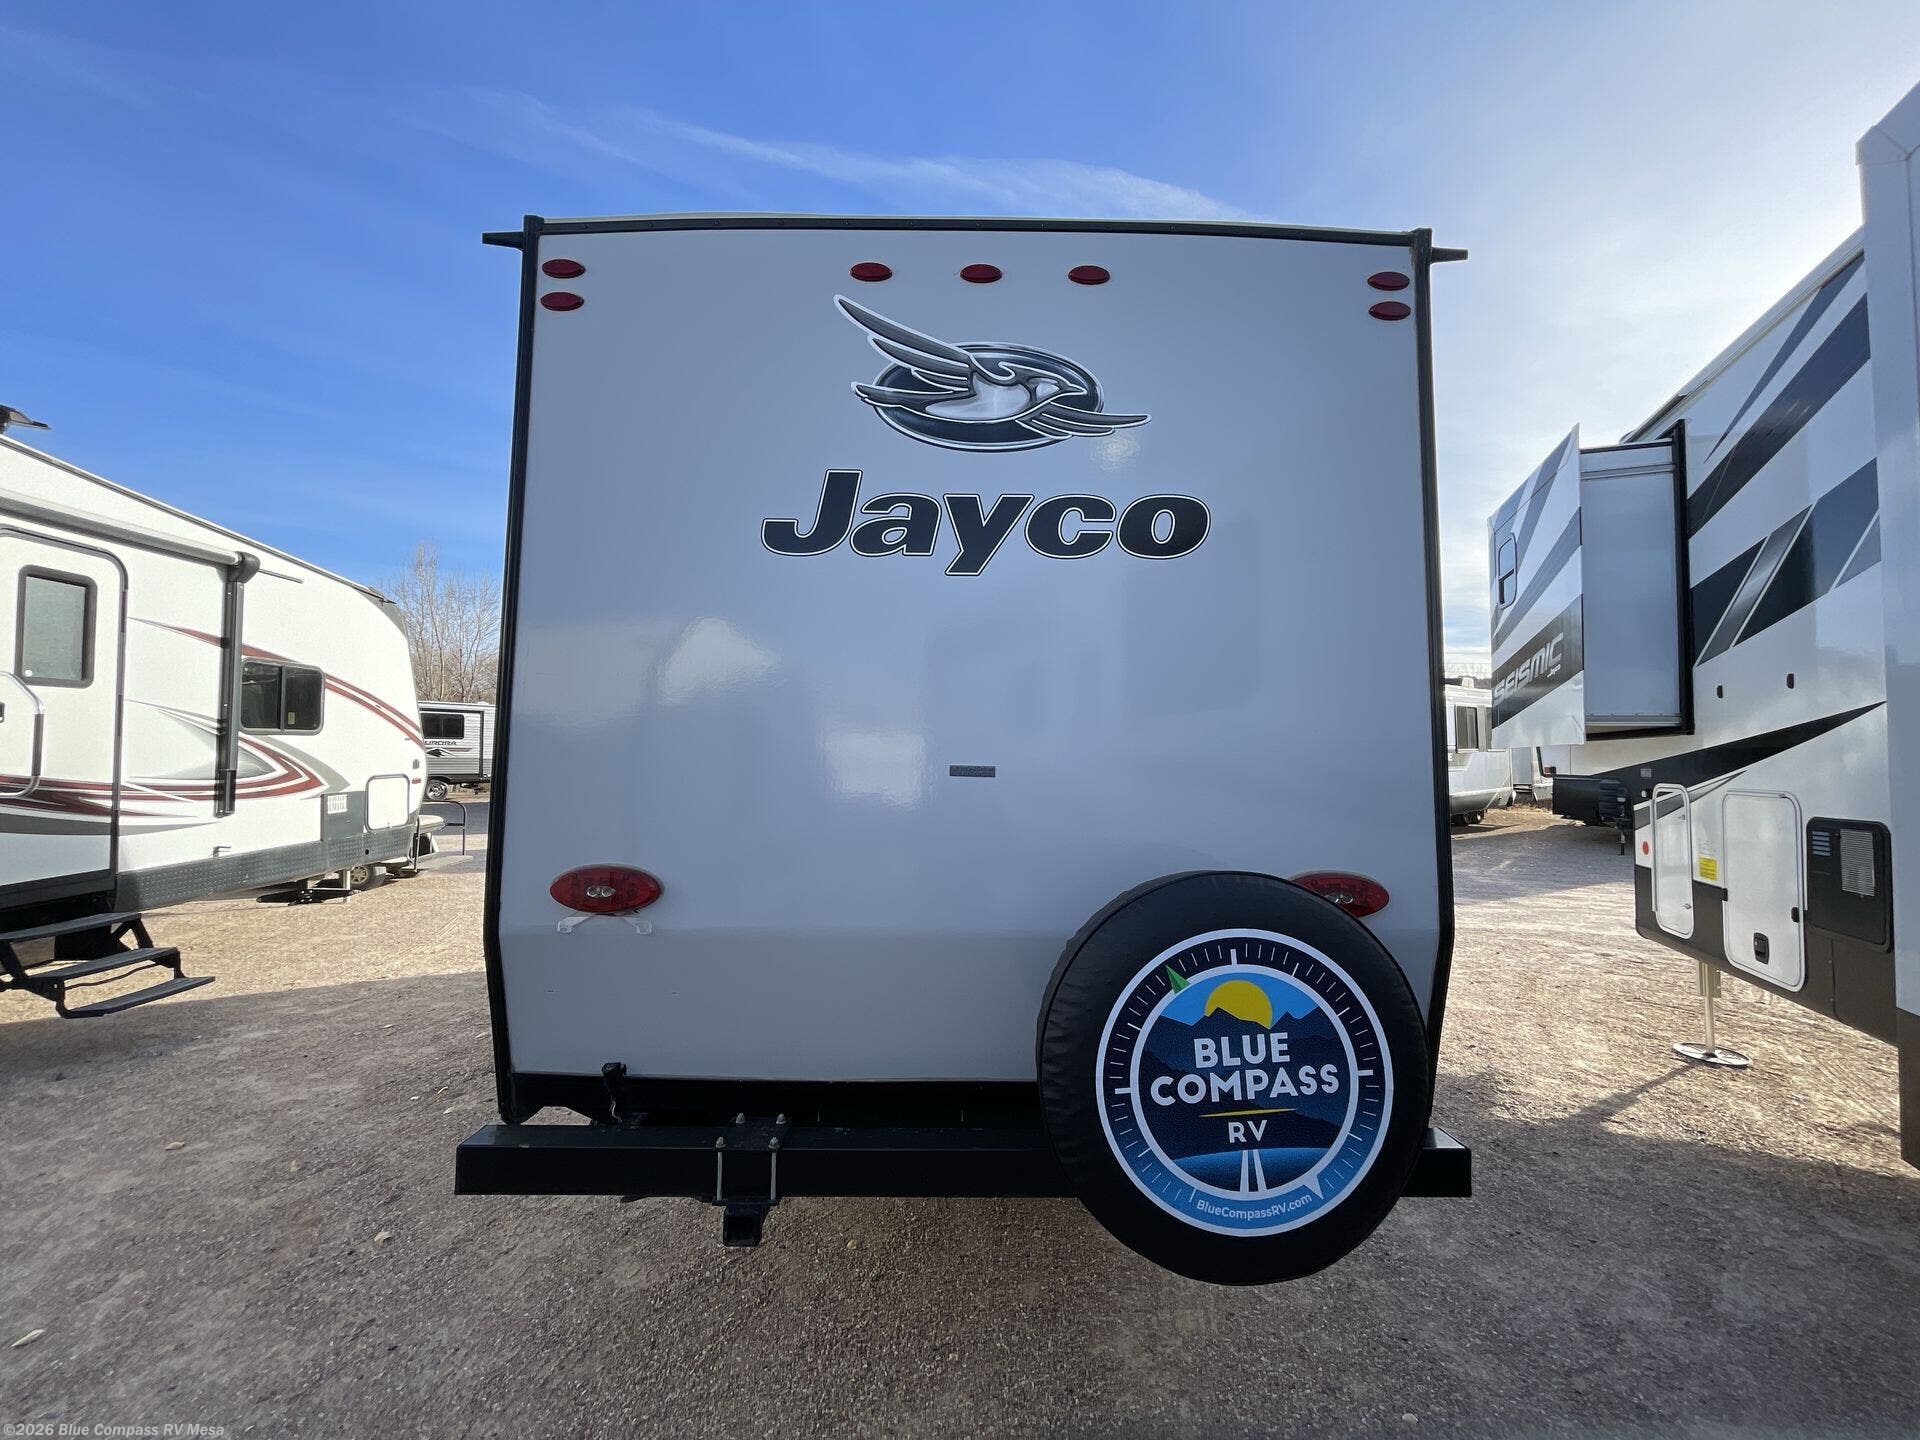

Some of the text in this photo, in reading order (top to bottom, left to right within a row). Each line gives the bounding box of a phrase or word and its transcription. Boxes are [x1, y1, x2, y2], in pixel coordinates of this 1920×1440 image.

[761, 468, 1212, 577] Jayco
[1493, 632, 1564, 707] SEISMIC
[1193, 1032, 1291, 1069] BLUE
[1150, 1063, 1340, 1106] COMPASS
[1228, 1119, 1268, 1144] RV
[1196, 1193, 1313, 1221] BlueCompassRV.com
